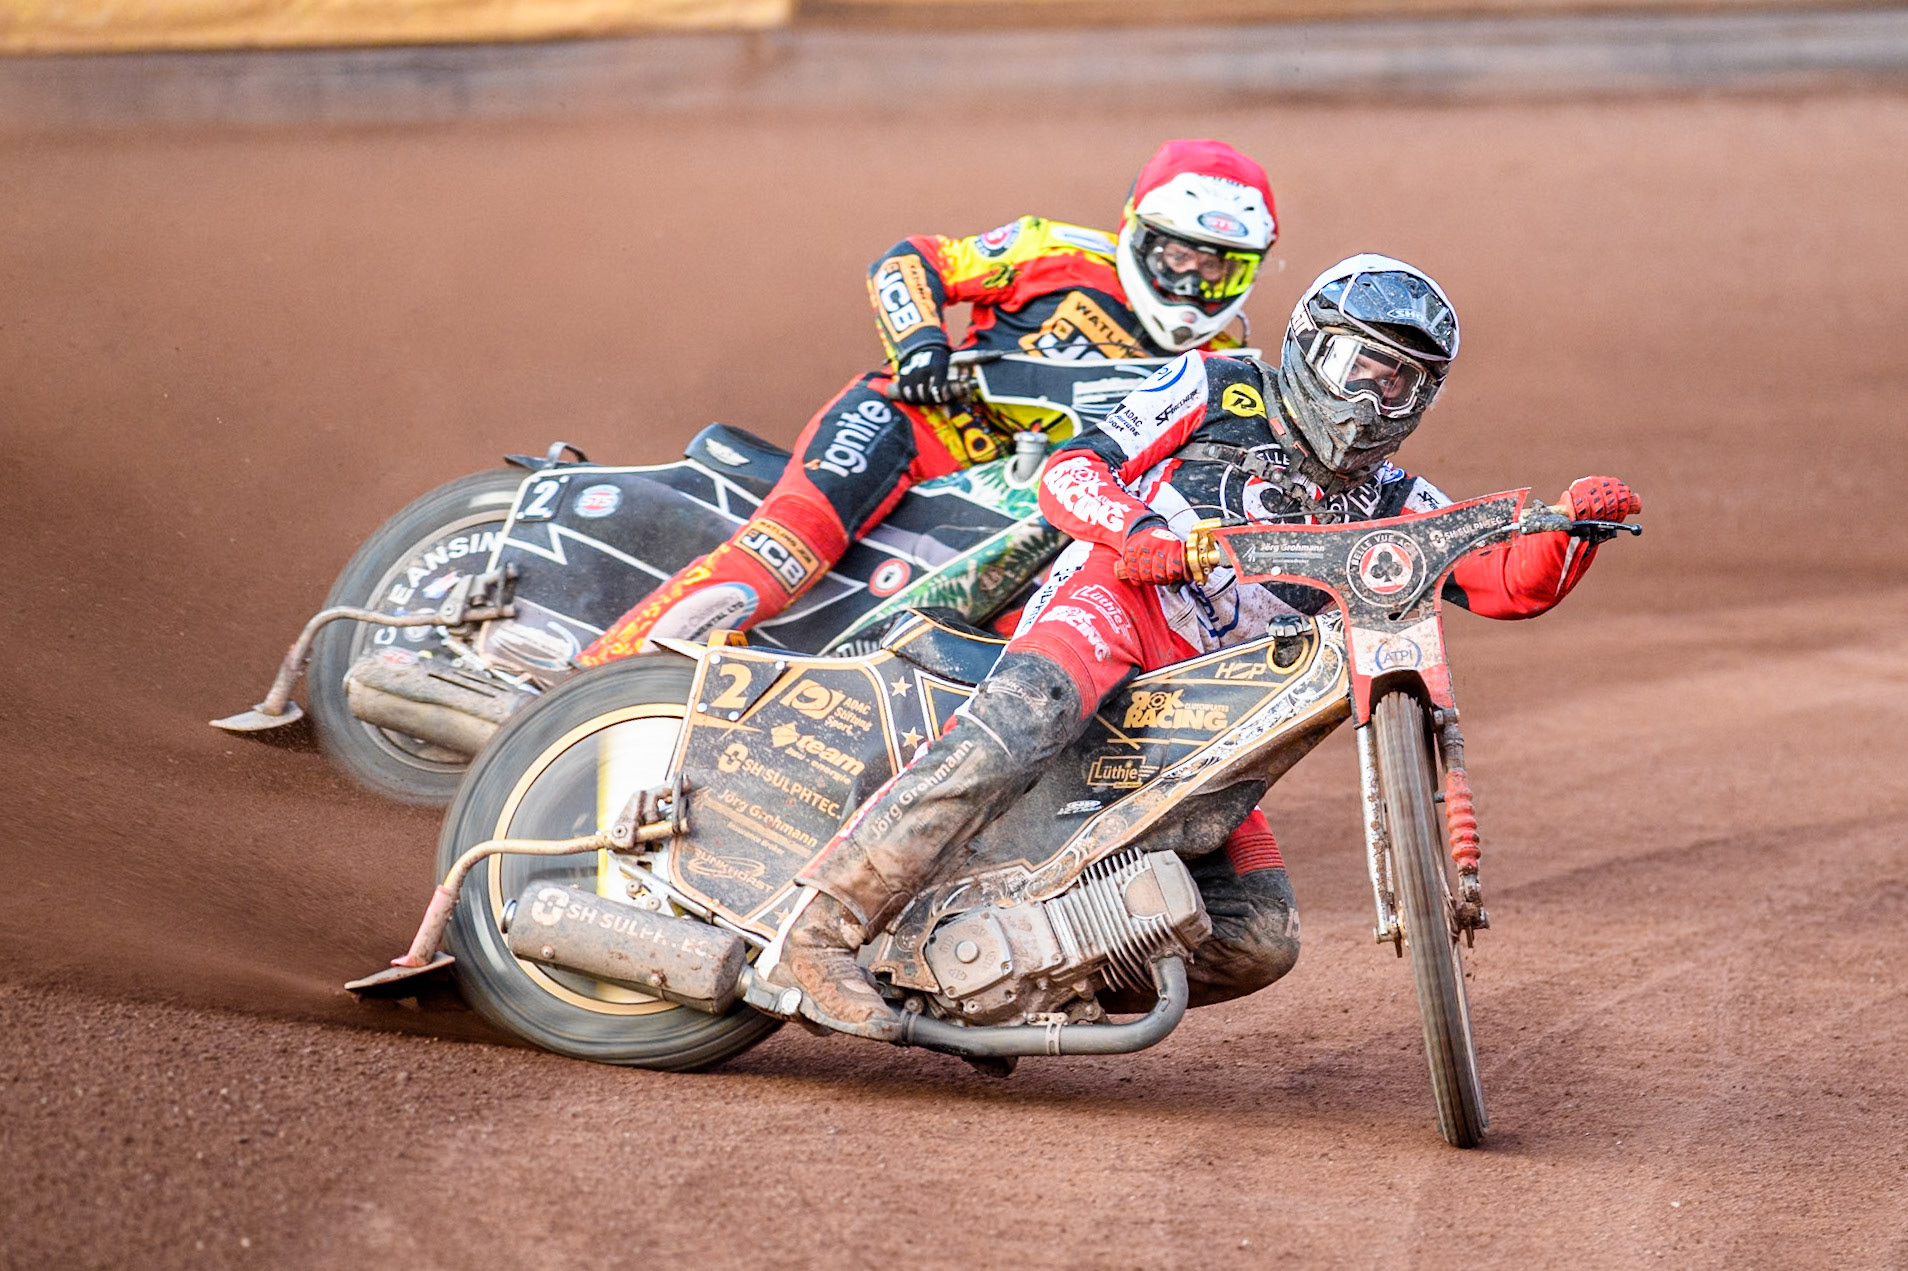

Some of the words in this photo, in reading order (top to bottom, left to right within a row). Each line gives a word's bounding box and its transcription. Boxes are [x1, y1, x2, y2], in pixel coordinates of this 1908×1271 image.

[878, 269, 922, 331] JCB
[1122, 408, 1143, 429] ADAC
[806, 400, 892, 478] ignite
[524, 480, 560, 516] 2
[741, 533, 806, 586] JCB
[1280, 542, 1325, 552] Grohmann
[1383, 649, 1413, 664] ATPI
[710, 663, 752, 709] 2
[842, 697, 871, 715] ADAC
[824, 715, 854, 736] Sport
[834, 707, 873, 732] Stiftung
[1122, 706, 1228, 732] RACING
[742, 758, 764, 777] SH
[796, 735, 865, 776] team
[1094, 763, 1138, 783] Lüthje
[871, 803, 903, 839] Jörg
[898, 740, 974, 806] Grohmann
[717, 788, 749, 813] Jörg
[748, 804, 818, 848] Grohmann
[566, 904, 598, 925] SH
